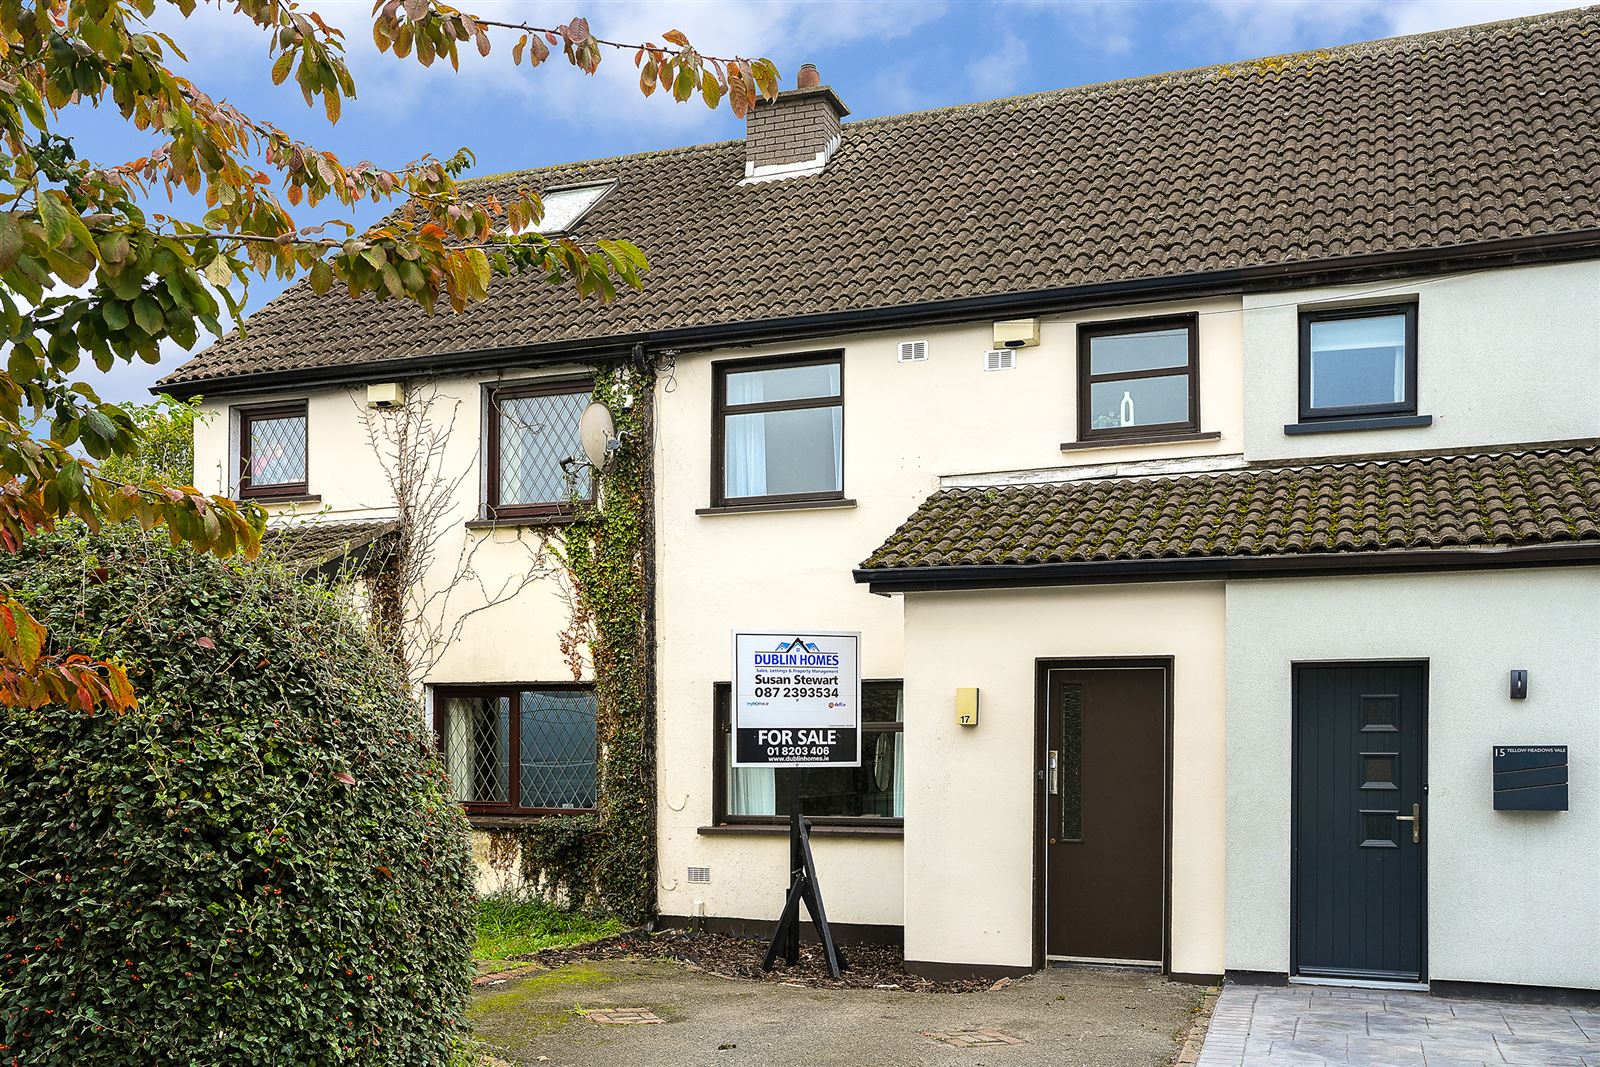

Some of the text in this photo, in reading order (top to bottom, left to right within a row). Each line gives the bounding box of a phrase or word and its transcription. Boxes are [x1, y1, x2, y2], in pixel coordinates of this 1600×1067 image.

[755, 654, 839, 666] DUBLIN HOMES
[755, 674, 838, 685] Susan Stewart
[755, 688, 839, 698] 087 2393534
[758, 730, 836, 745] FOR SALE
[767, 747, 829, 755] 01 8203 406
[1495, 748, 1506, 757] 15
